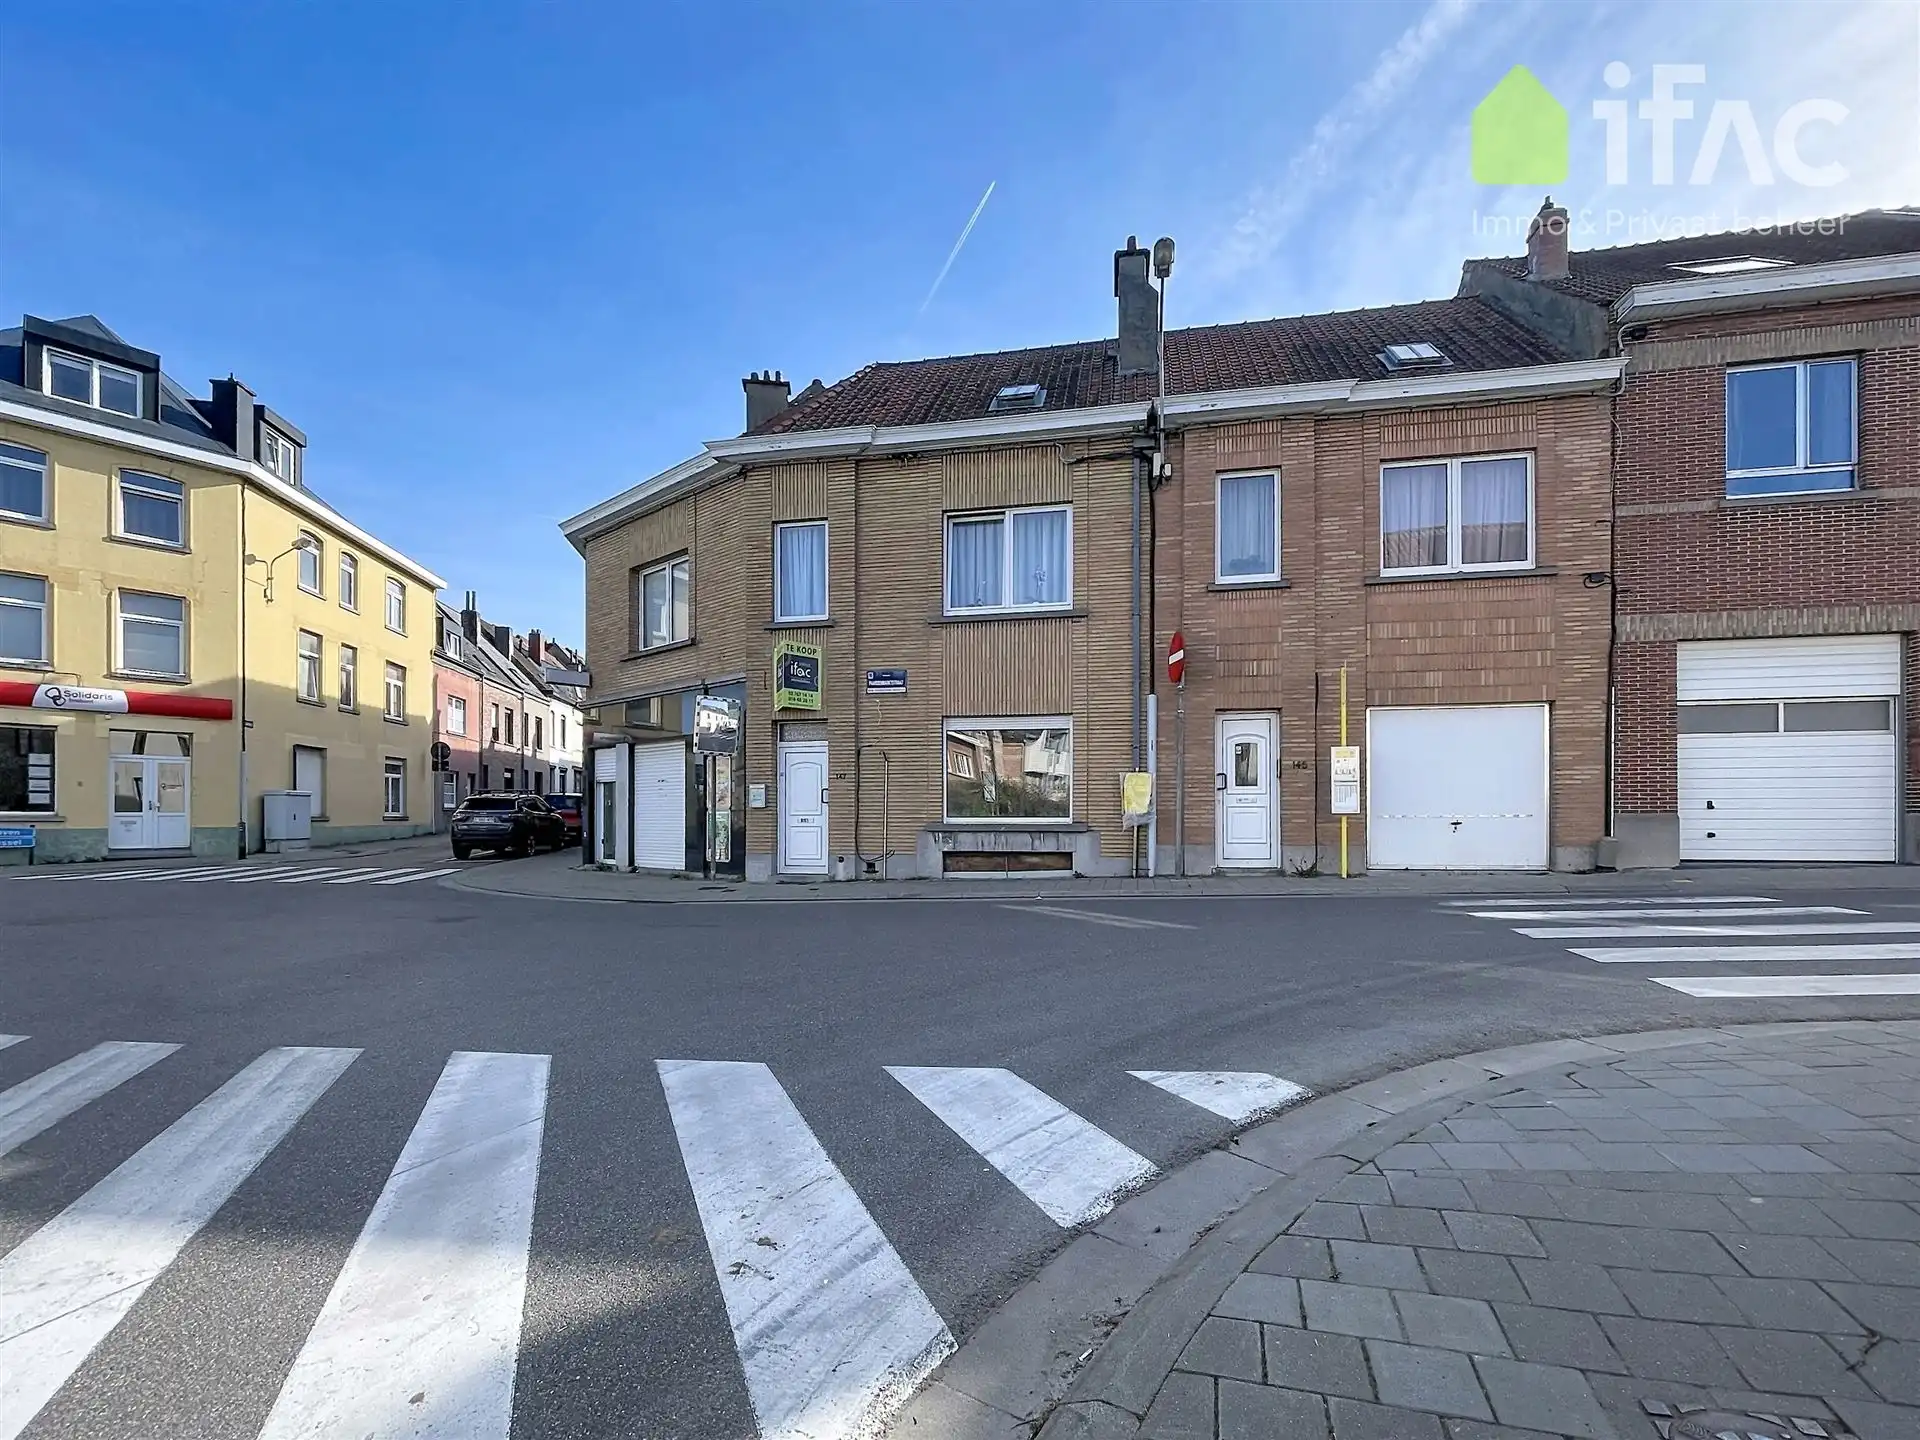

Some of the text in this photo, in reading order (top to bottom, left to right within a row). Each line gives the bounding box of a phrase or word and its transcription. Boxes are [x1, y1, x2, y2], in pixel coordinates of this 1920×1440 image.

[785, 644, 817, 656] TE KOOP
[790, 660, 812, 678] ifac
[63, 689, 114, 700] Solidaris
